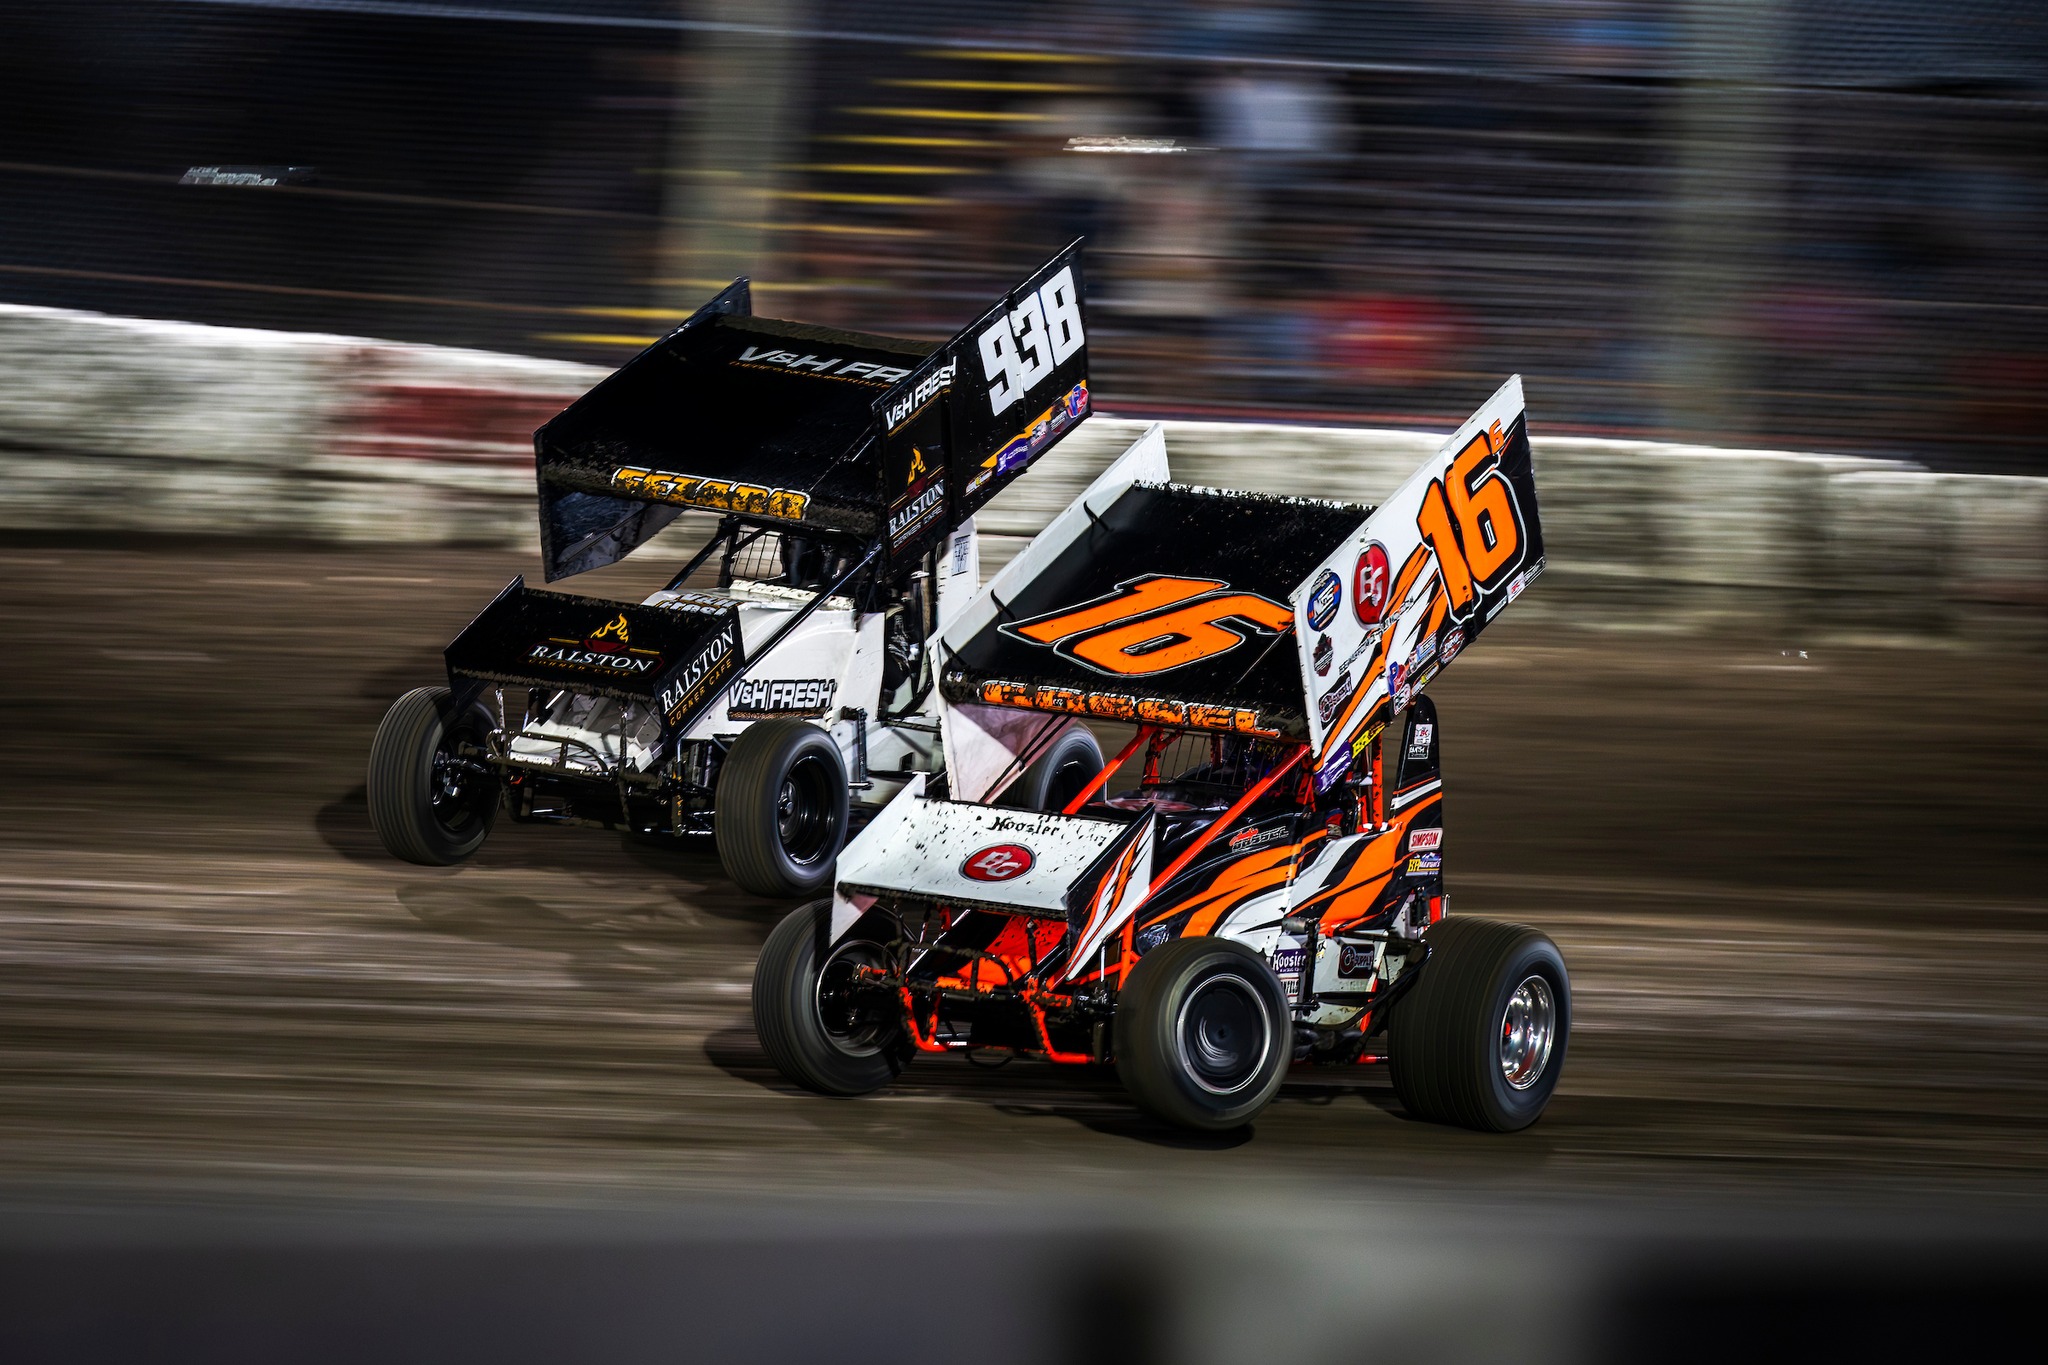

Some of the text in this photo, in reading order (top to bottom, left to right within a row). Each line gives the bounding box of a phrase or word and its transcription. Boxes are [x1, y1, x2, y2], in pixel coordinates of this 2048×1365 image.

[735, 346, 843, 372] V&H
[978, 266, 1085, 416] 938
[885, 392, 913, 431] V&H
[914, 356, 957, 409] FRESH
[889, 479, 944, 537] RALSTON
[1416, 430, 1526, 620] 16
[999, 574, 1295, 677] 16
[529, 645, 654, 672] RALSTON
[661, 623, 735, 715] RALSTON
[669, 658, 733, 727] CORNER CAFE
[729, 680, 834, 709] V&H FRESH
[986, 816, 1060, 836] Hoosier
[1411, 832, 1439, 847] SIMPSON
[1273, 951, 1306, 971] Hoosier
